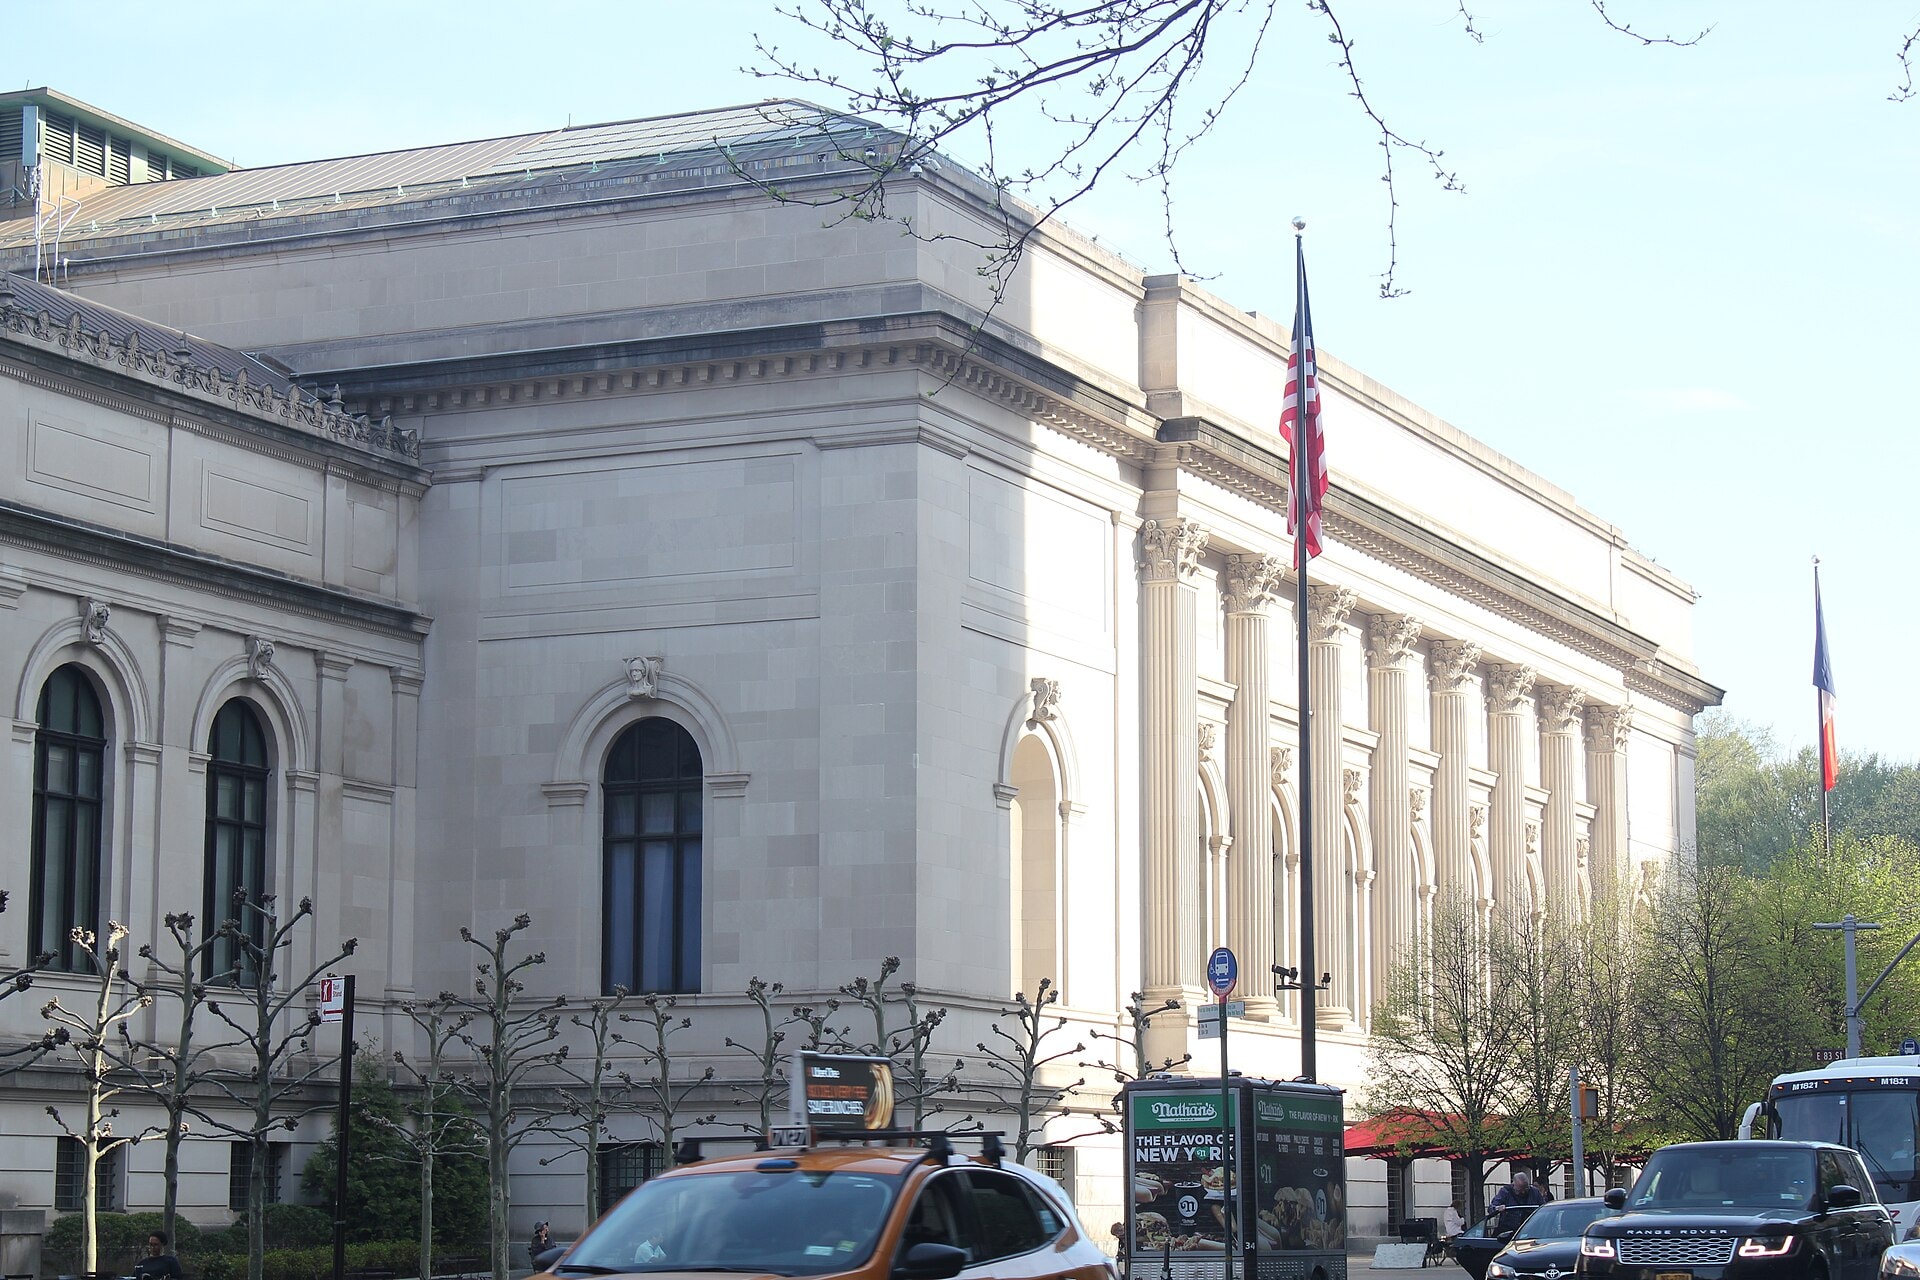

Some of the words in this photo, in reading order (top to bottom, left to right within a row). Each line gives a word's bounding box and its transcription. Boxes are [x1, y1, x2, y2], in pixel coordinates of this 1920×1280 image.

[1823, 1051, 1833, 1061] 83
[1881, 1077, 1909, 1085] M1821
[1792, 1082, 1819, 1091] M1821
[1151, 1102, 1217, 1122] Nathan's
[1136, 1136, 1160, 1146] THE
[1164, 1134, 1213, 1146] FLAVOR
[1136, 1147, 1179, 1162] NEW
[1245, 1241, 1255, 1250] 34
